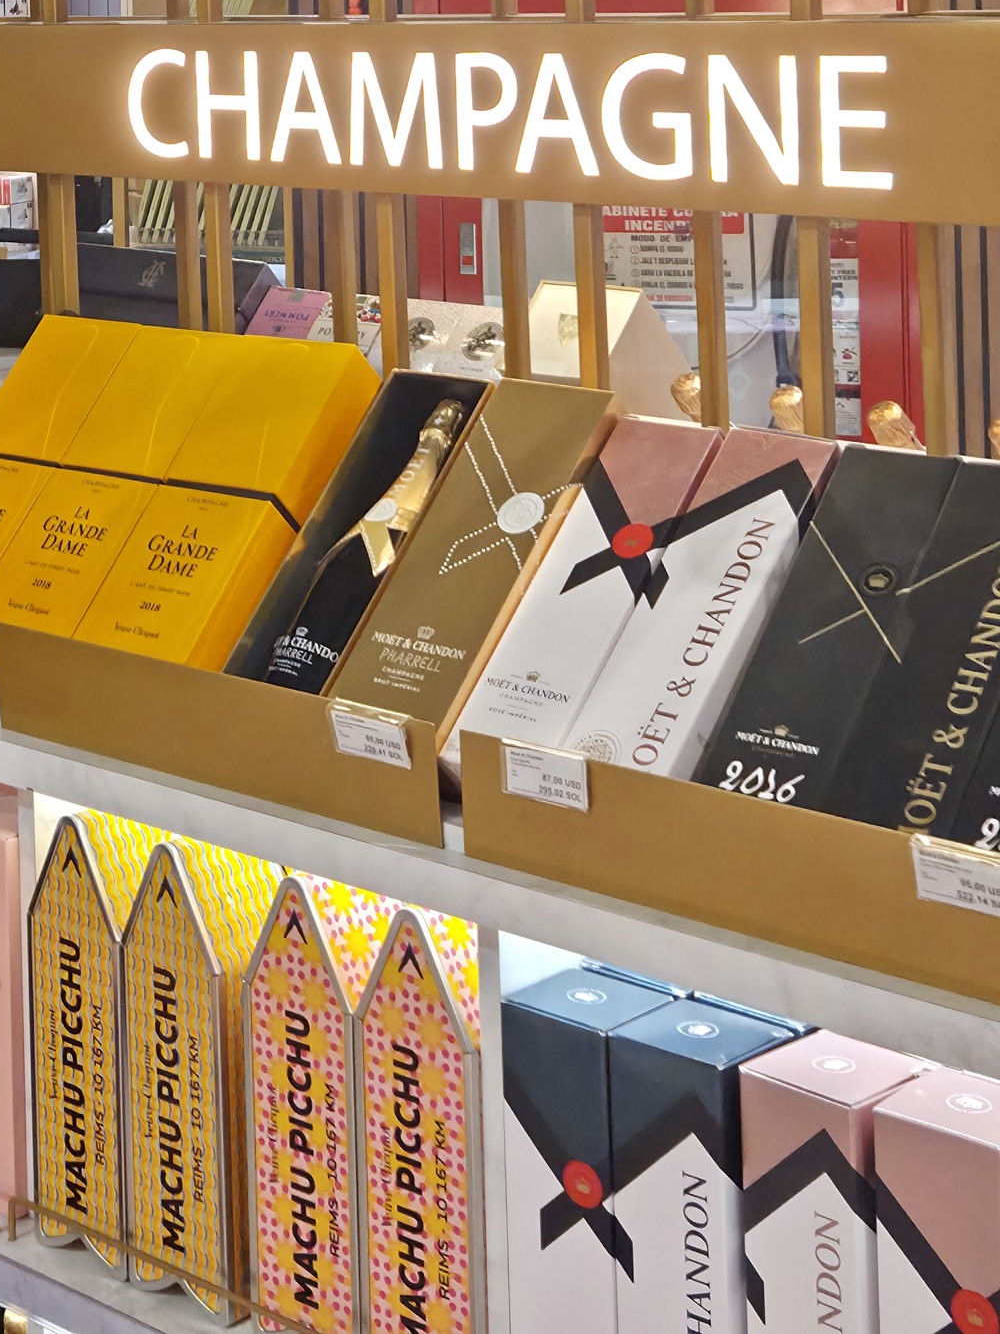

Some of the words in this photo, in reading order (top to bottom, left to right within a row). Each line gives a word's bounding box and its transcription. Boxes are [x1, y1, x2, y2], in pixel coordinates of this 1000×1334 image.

[127, 48, 894, 191] CHAMPAGNE
[602, 206, 669, 217] ABINETE
[676, 235, 693, 243] EMP
[74, 506, 91, 520] LA
[42, 514, 109, 542] GRANDE
[181, 525, 198, 540] LA
[41, 533, 89, 557] DAME
[148, 533, 219, 561] GRANDE
[146, 554, 199, 578] DAME
[31, 578, 52, 589] 2018
[139, 601, 162, 612] 2018
[291, 636, 339, 663] CHANDO
[402, 638, 412, 649] &
[413, 641, 466, 660] CHANDON
[632, 702, 680, 766] OËT
[666, 675, 697, 698] &
[682, 517, 776, 667] CHANDON
[946, 568, 1000, 715] CHAND
[379, 647, 441, 673] PHARRELL
[521, 685, 570, 703] CHANDON
[771, 738, 820, 756] CHANDON
[931, 724, 970, 749] &
[565, 778, 582, 790] USD
[719, 760, 806, 803] 2016
[897, 753, 954, 832] OËT
[566, 791, 583, 803] SOL
[988, 886, 1000, 896] US
[59, 937, 83, 1074] PICCHU
[92, 1004, 102, 1028] KM
[93, 1033, 103, 1066] 167
[154, 966, 180, 1107] PICCHU
[189, 1035, 199, 1061] KM
[95, 1074, 104, 1094] 10
[191, 1065, 201, 1099] 167
[285, 1010, 313, 1156] PICCHU
[324, 1082, 335, 1113] KM
[191, 1107, 202, 1130] 10
[392, 1043, 422, 1196] PICCHU
[65, 1082, 88, 1214] MACHU
[95, 1120, 105, 1166] REIMS
[326, 1116, 337, 1152] 167
[434, 1120, 445, 1151] KM
[194, 1154, 204, 1204] REIMS
[328, 1158, 338, 1183] 10
[435, 1154, 447, 1190] 167
[158, 1119, 185, 1254] MACHU
[437, 1195, 448, 1222] 10
[290, 1166, 319, 1310] MACHU
[329, 1199, 339, 1258] REIMS
[682, 1170, 712, 1334] HANDON
[438, 1239, 450, 1300] REIMS
[814, 1210, 843, 1333] NDON
